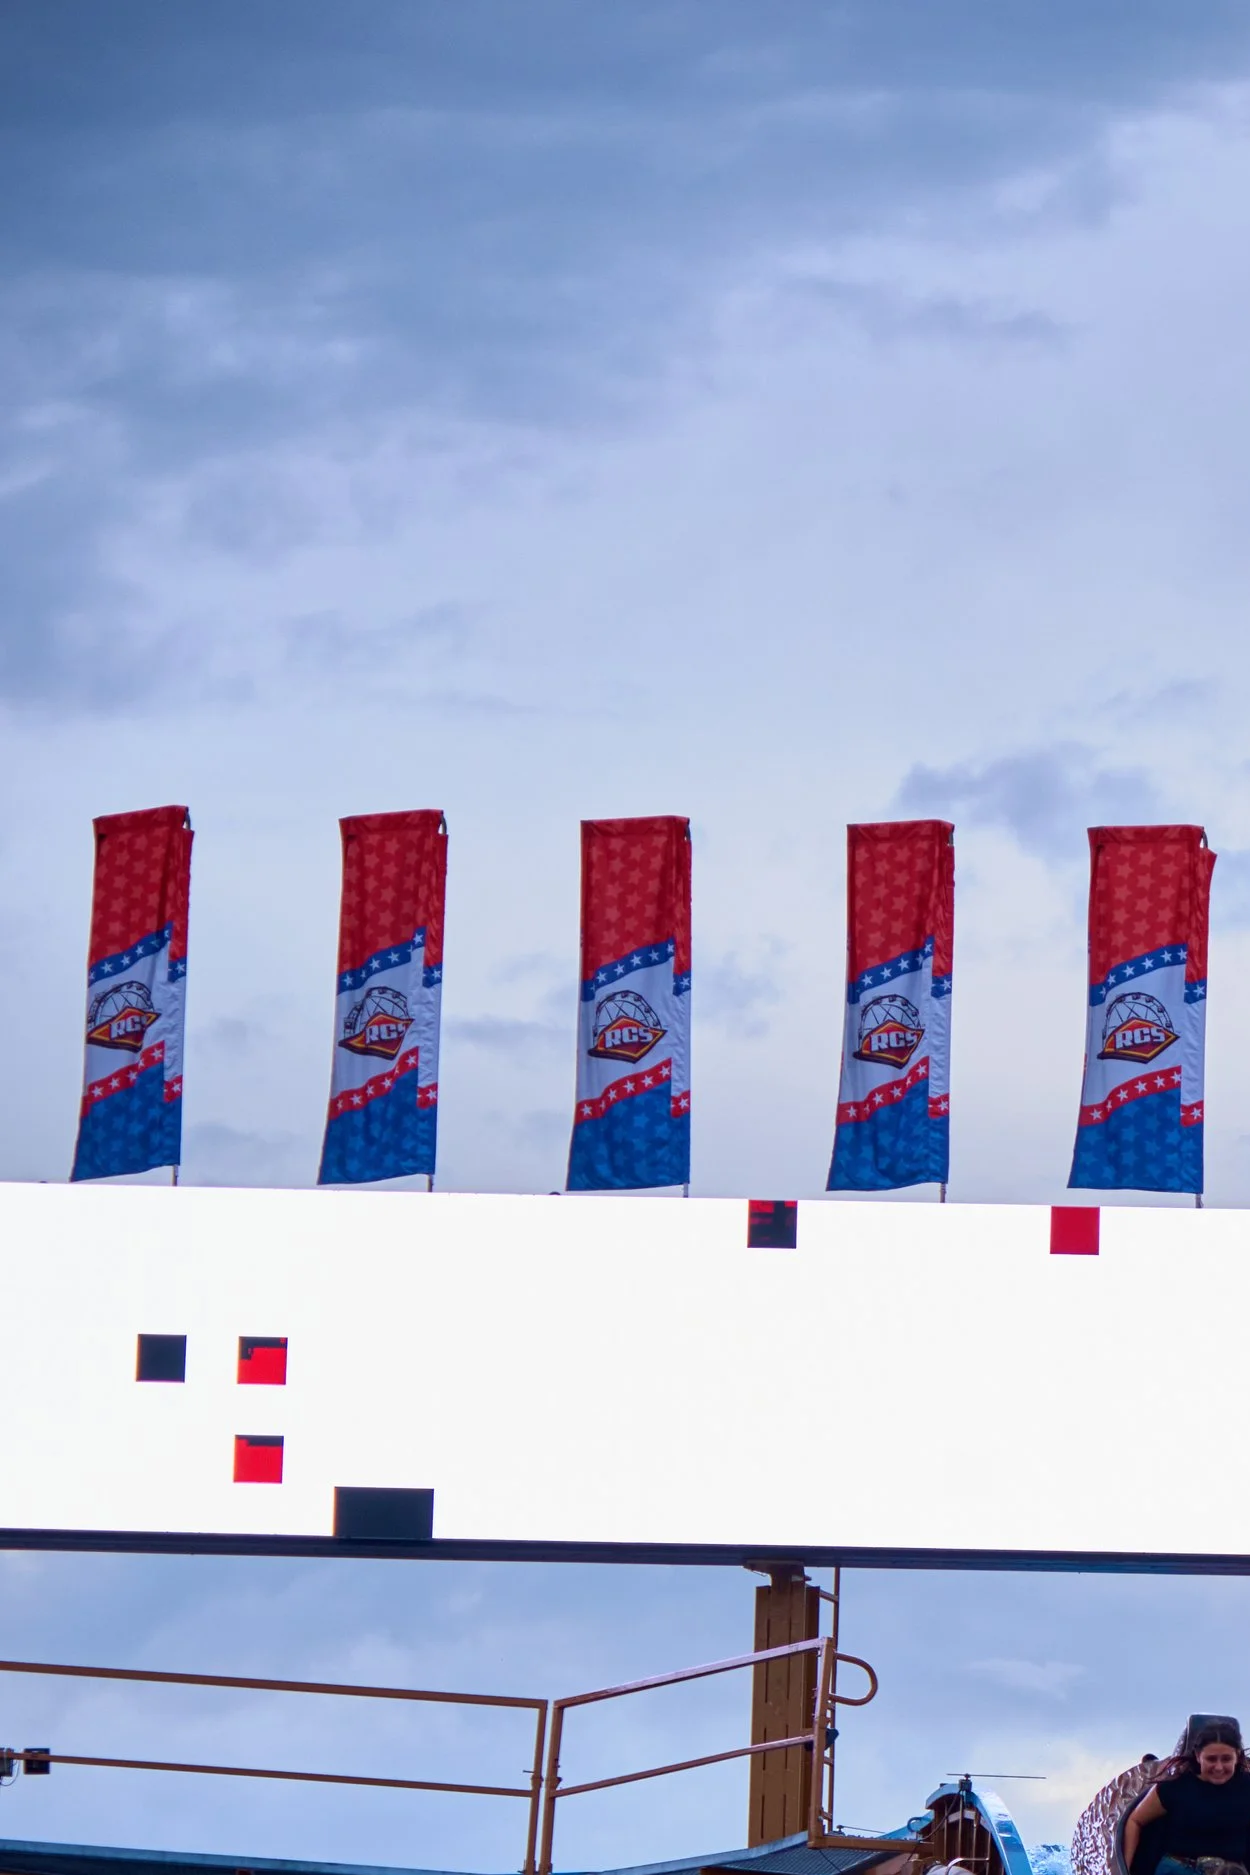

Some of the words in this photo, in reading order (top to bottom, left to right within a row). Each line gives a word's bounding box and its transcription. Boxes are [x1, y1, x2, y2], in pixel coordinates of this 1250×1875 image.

[604, 1027, 653, 1048] RCS
[871, 1031, 917, 1051] RCS
[1115, 1027, 1165, 1049] RCS
